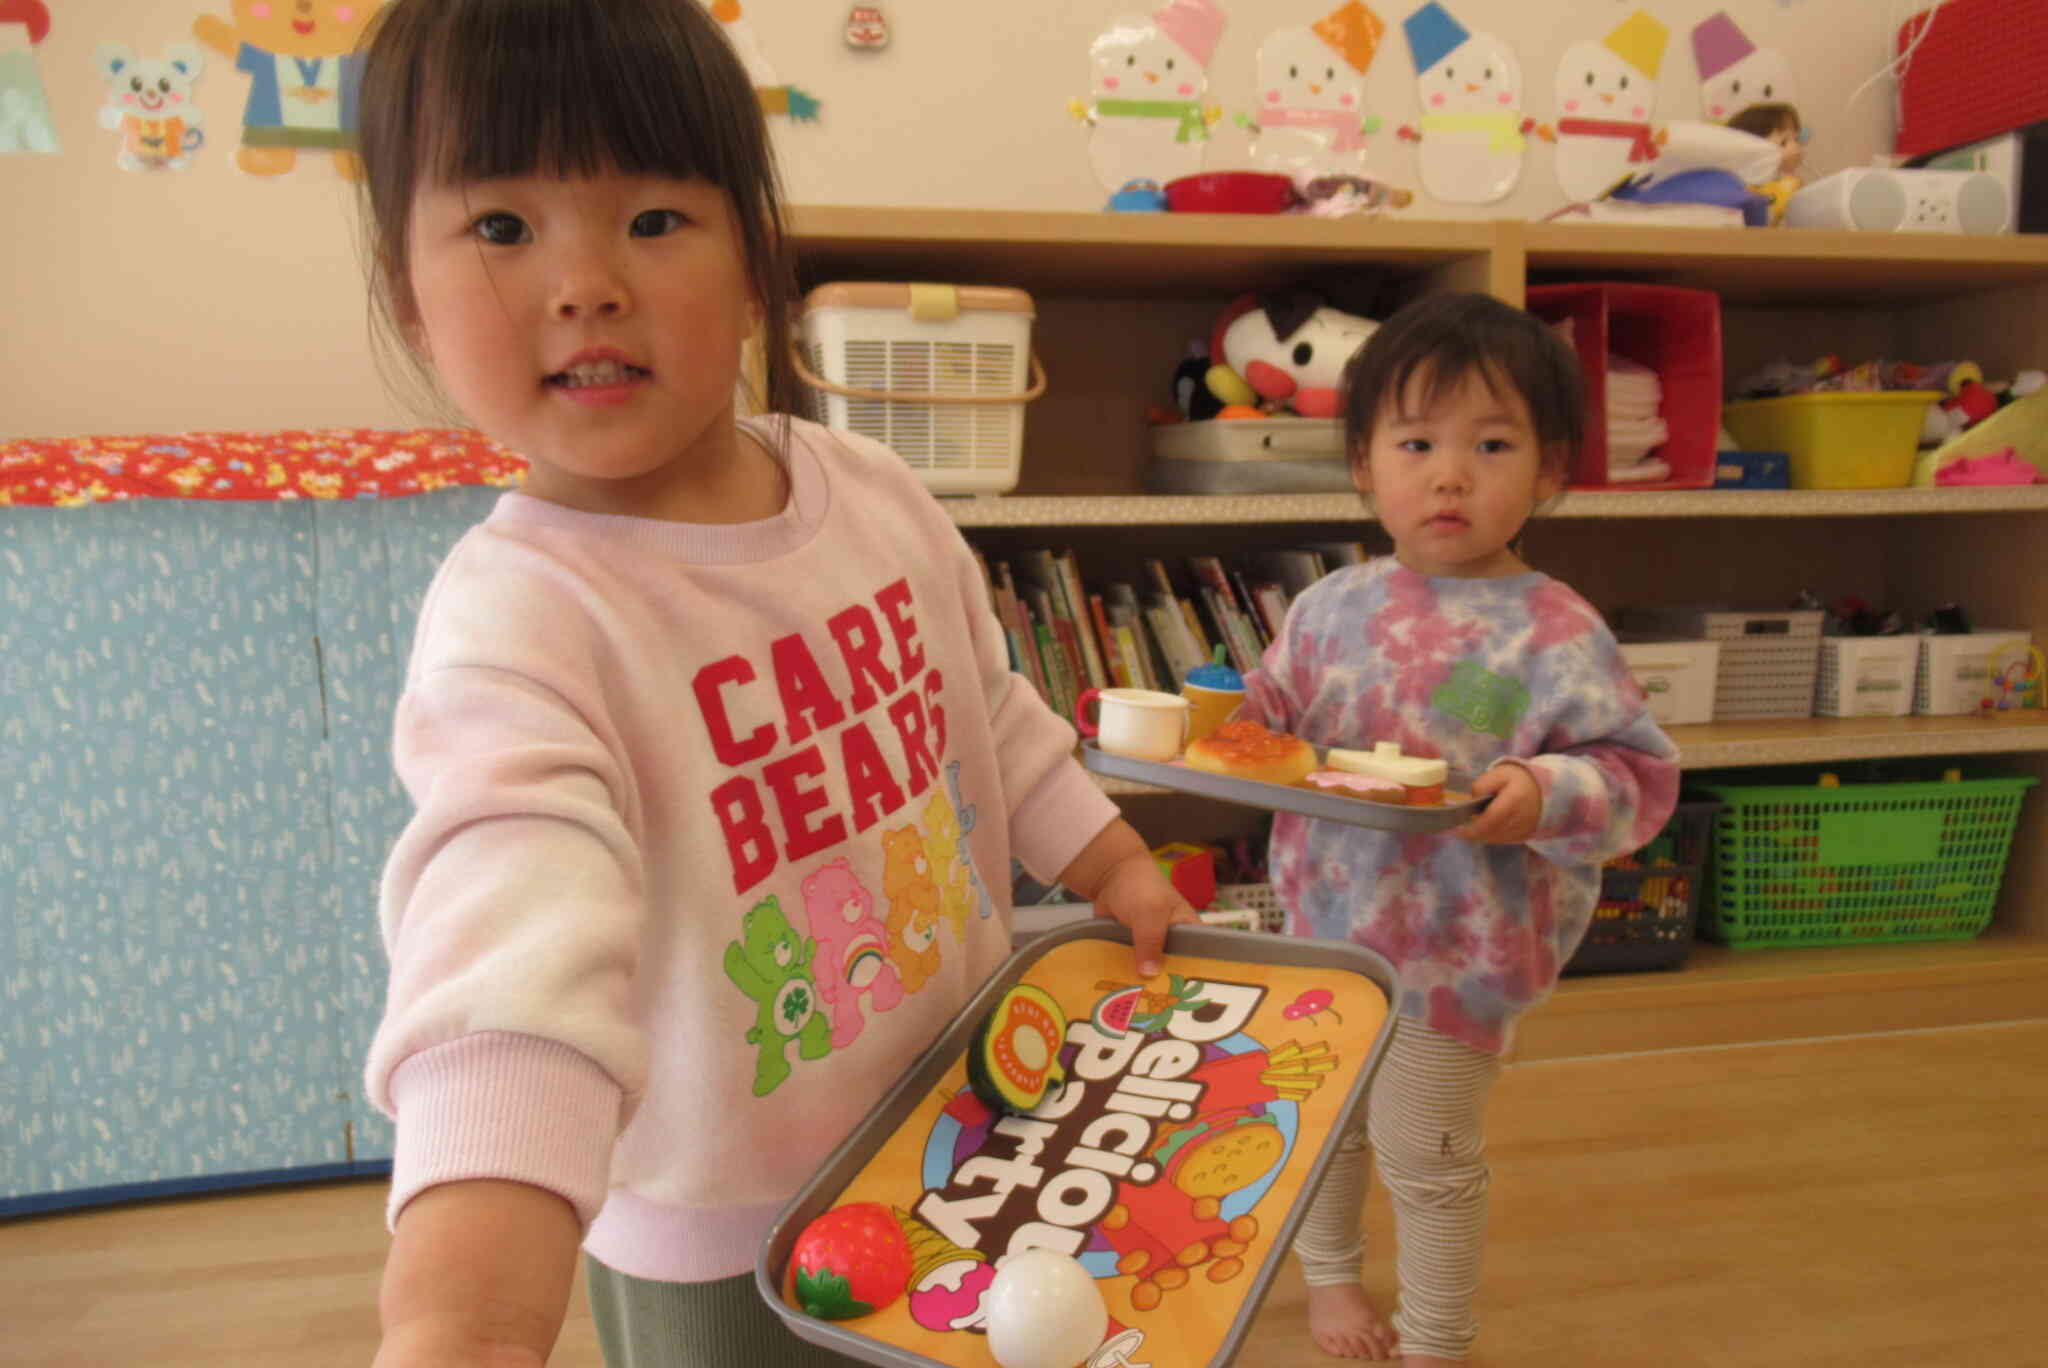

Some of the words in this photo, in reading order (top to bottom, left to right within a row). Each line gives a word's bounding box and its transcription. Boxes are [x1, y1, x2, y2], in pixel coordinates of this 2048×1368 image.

[692, 577, 926, 767] CARE
[710, 668, 946, 896] BEARS
[994, 979, 1267, 1260] Delicio
